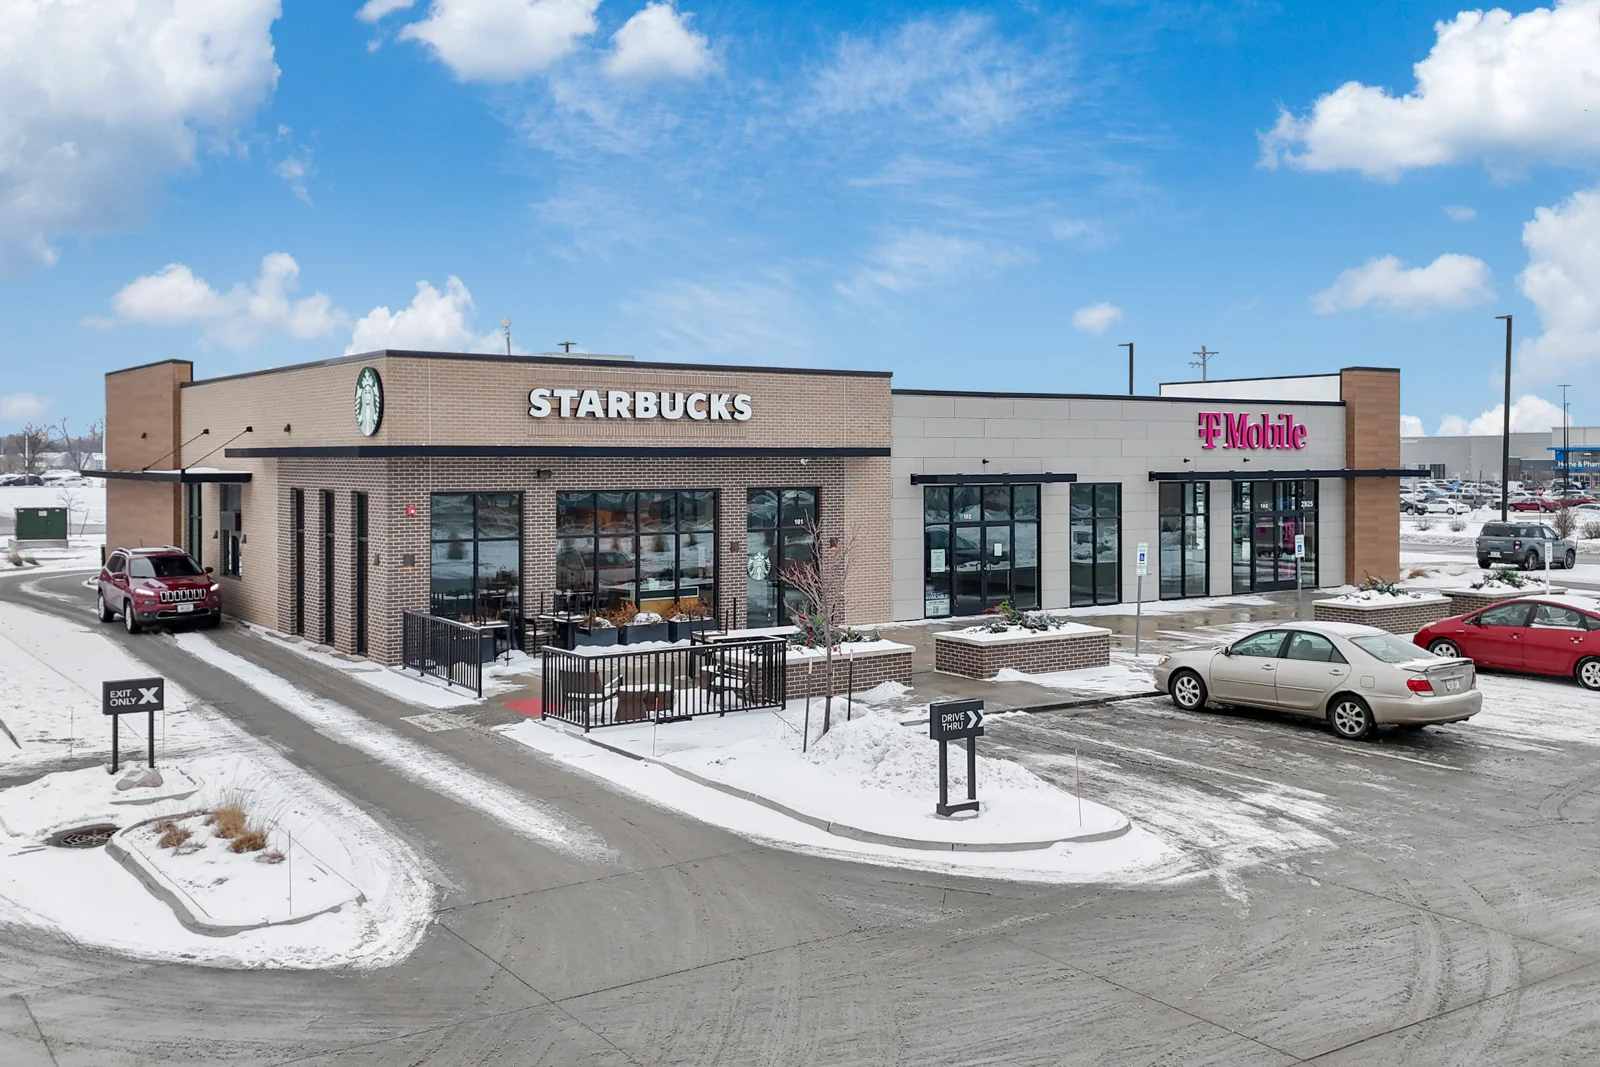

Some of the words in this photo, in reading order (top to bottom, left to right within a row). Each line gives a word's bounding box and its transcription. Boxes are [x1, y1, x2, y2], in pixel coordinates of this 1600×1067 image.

[528, 388, 752, 421] STARBUCKS
[109, 689, 132, 698] EXIT
[109, 697, 137, 707] ONLY
[941, 712, 965, 723] DRIVE
[941, 721, 963, 732] THRU
